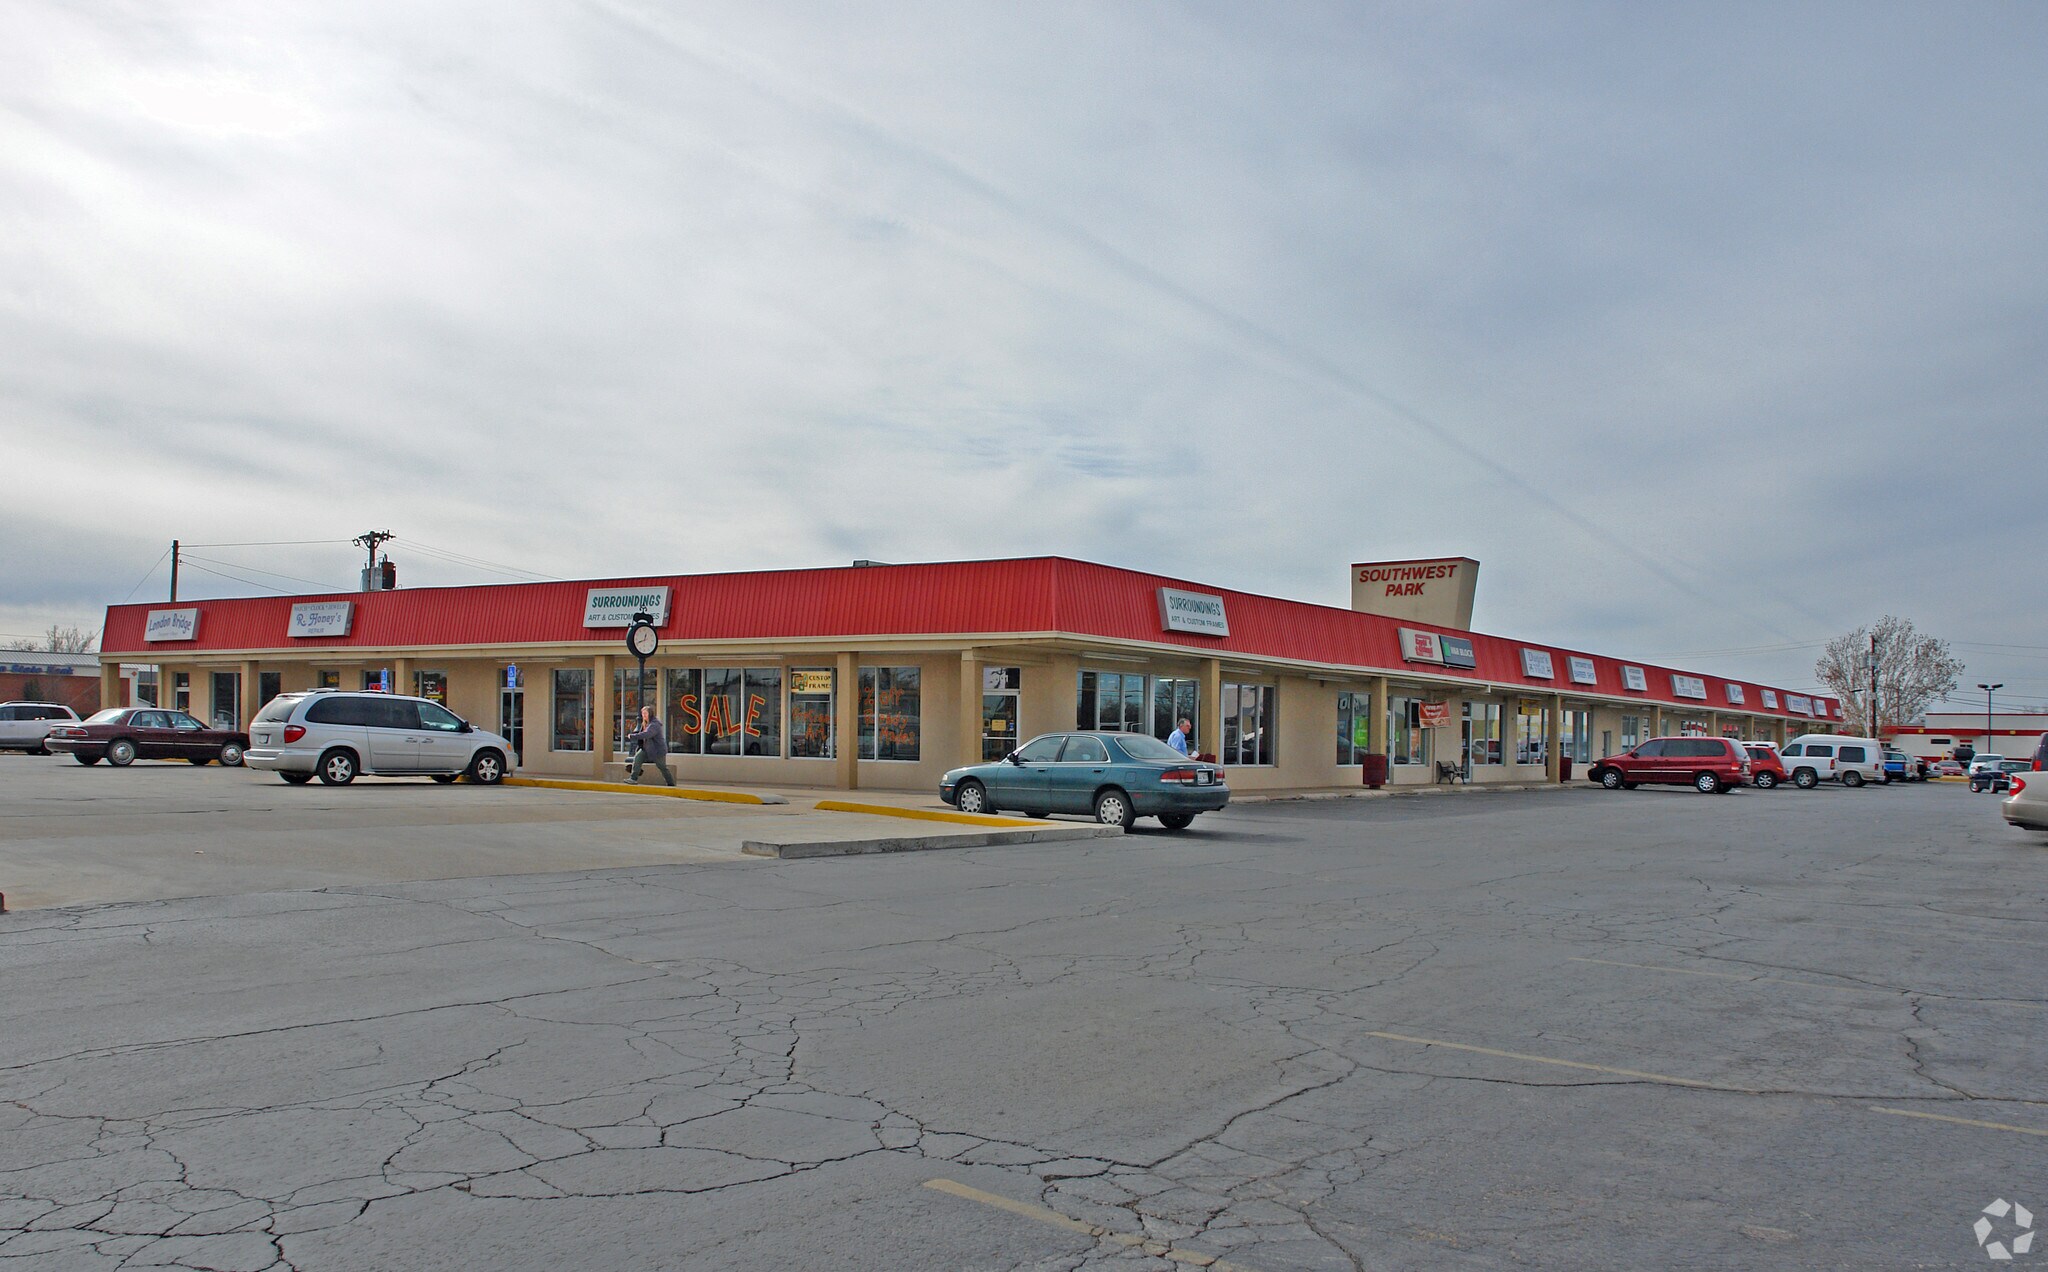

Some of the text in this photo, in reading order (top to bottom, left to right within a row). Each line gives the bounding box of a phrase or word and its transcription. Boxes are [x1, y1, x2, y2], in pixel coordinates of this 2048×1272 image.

[1359, 564, 1458, 583] SOUTHWEST
[1385, 582, 1426, 597] PARK
[592, 594, 661, 608] SURROUNDINGS
[1169, 595, 1221, 616] SURROUNDINGS
[148, 612, 192, 634] London Bridge
[607, 613, 633, 621] CUSTOM
[1171, 615, 1181, 623] ART
[1186, 617, 1206, 626] CUSTOM
[1206, 620, 1225, 629] FRAMES
[1459, 648, 1475, 658] BLOCK
[680, 694, 765, 738] SALE
